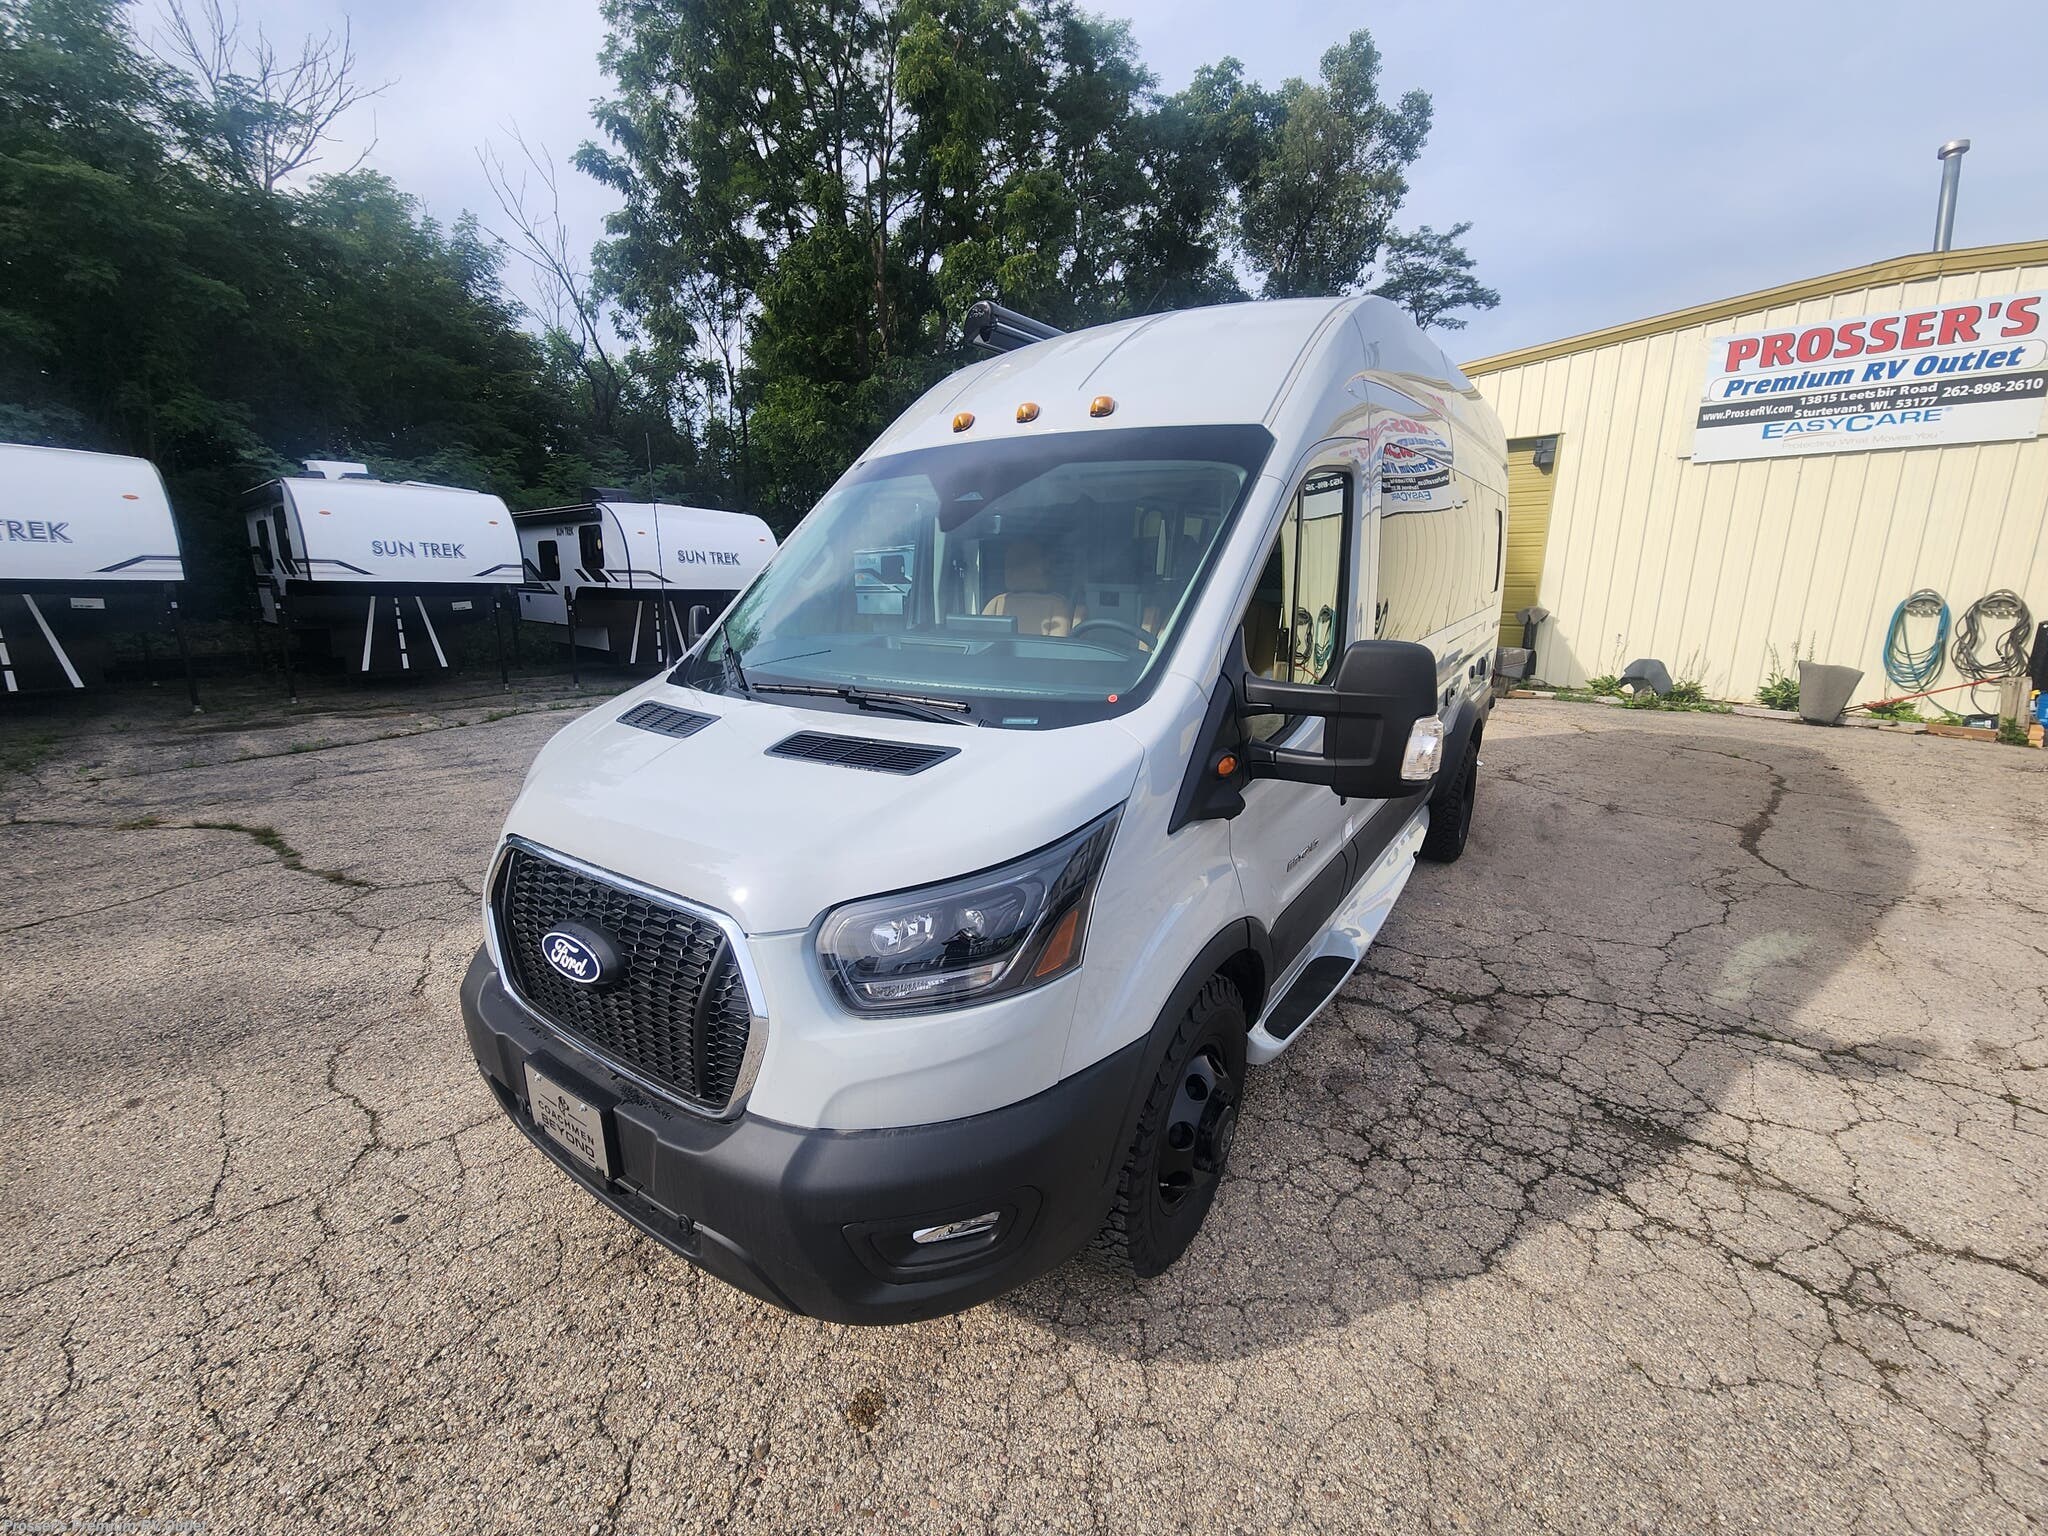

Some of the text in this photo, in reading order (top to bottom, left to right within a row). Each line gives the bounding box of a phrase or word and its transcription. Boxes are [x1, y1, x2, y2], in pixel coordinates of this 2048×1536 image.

[1724, 296, 2042, 373] PROSSER'S
[1723, 345, 2027, 398] Premium RV Outlet
[1800, 393, 1838, 406] 13815
[1900, 382, 1939, 396] Road
[1941, 377, 2044, 399] 262-898-2610
[1702, 403, 1794, 421] www.ProsserRV.com
[1870, 400, 1893, 412] WI.
[1895, 396, 1939, 409] 53177
[372, 540, 467, 559] SUN TREK
[677, 549, 742, 566] SUN TREK
[550, 938, 588, 978] Ford
[538, 1099, 595, 1146] COACHMEN
[540, 1111, 596, 1160] BEYOND
